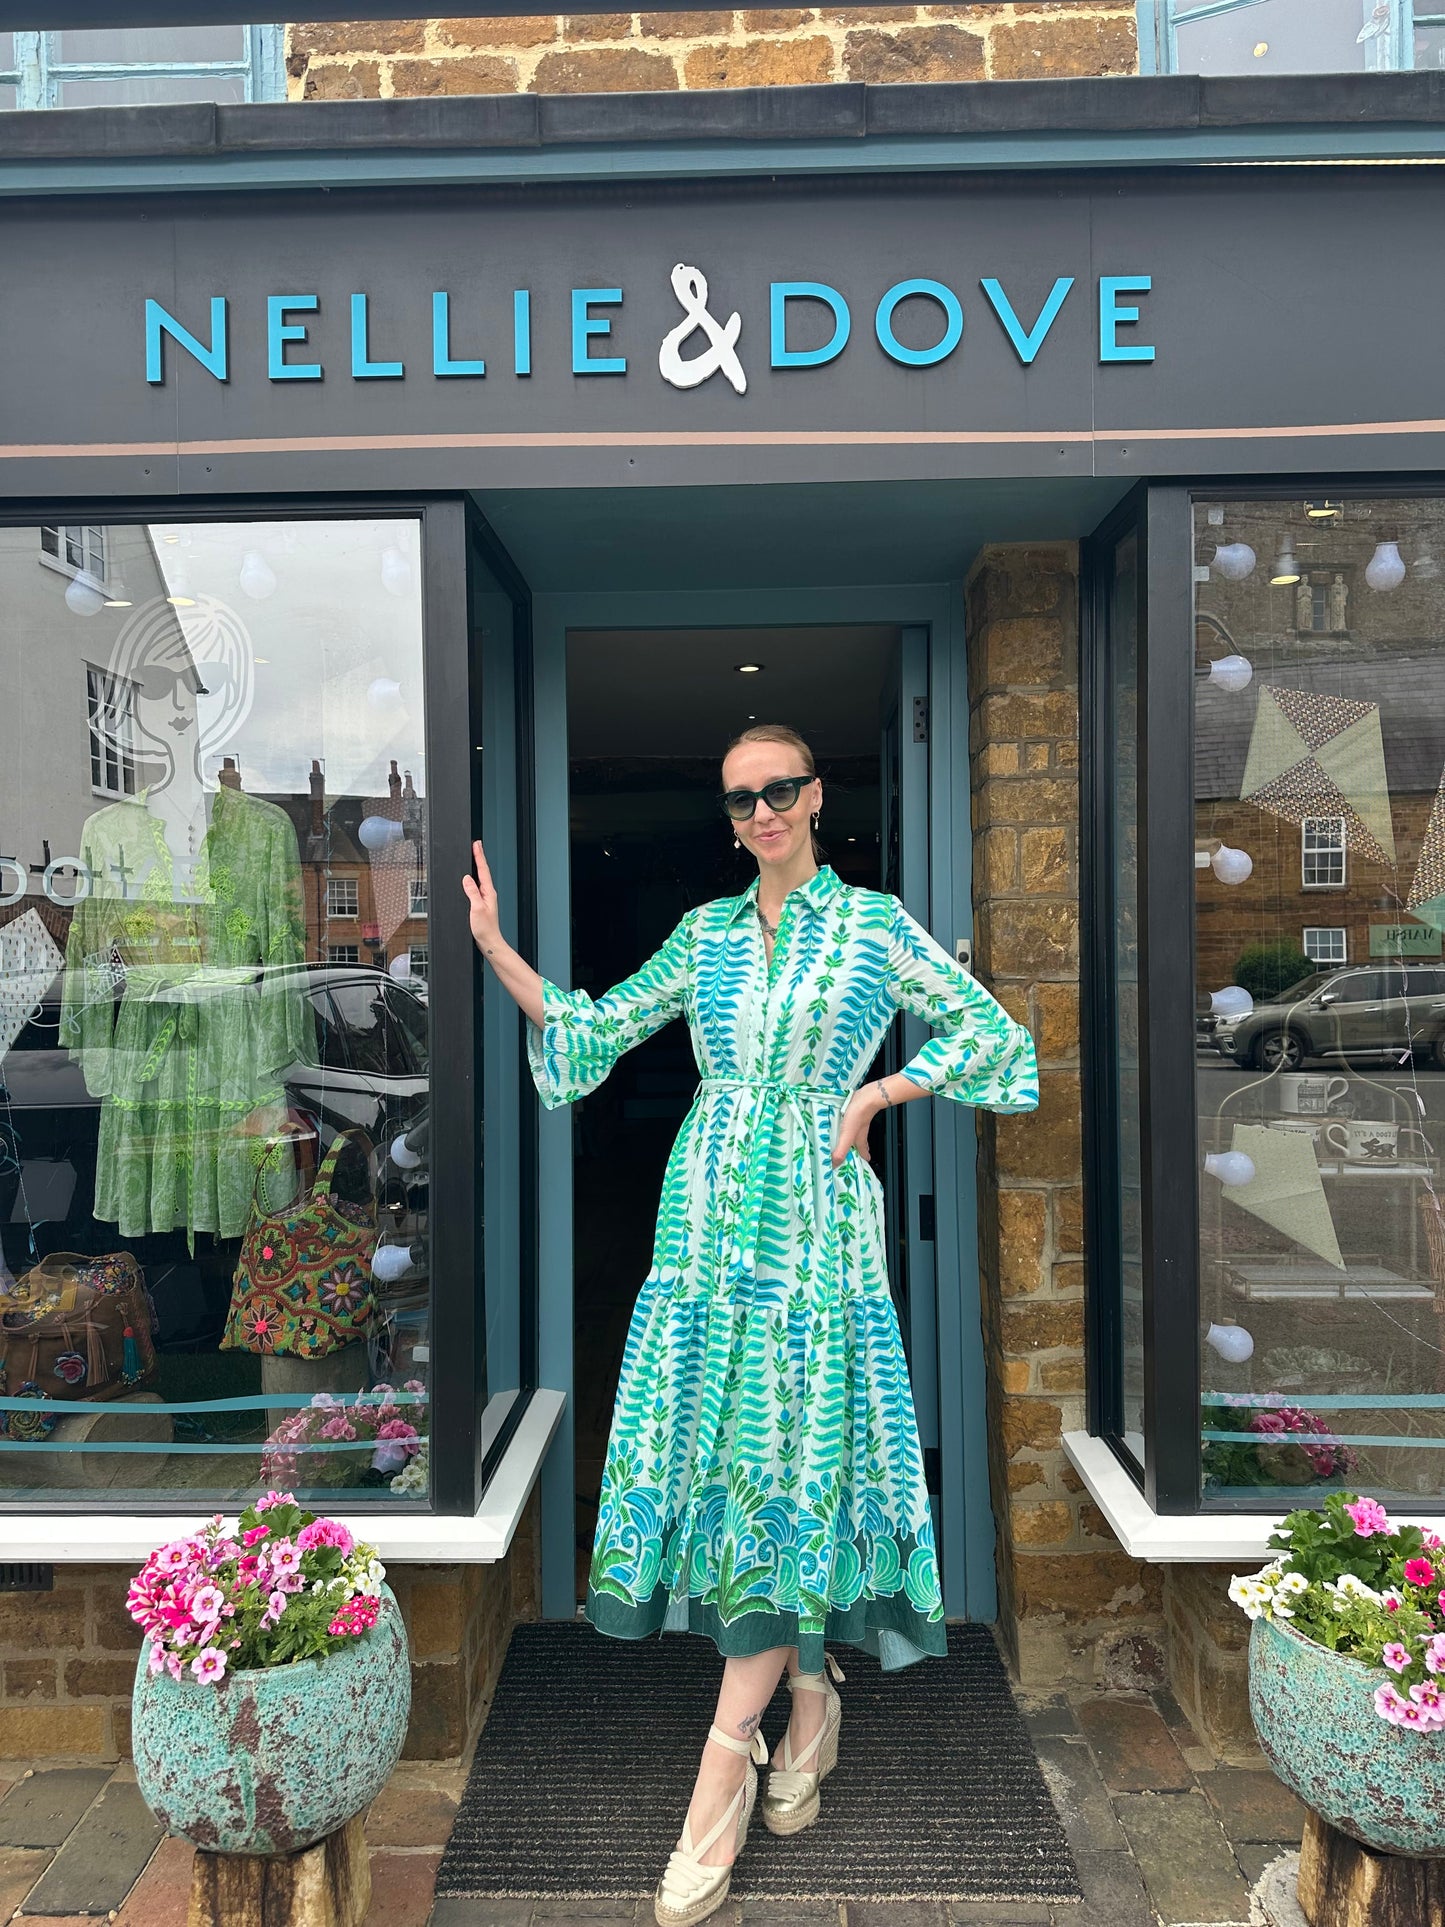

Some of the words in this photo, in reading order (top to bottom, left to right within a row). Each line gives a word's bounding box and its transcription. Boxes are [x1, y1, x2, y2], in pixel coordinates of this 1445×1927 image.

[145, 288, 628, 384] NELLIE
[659, 262, 747, 395] &
[769, 274, 1157, 369] DOVE
